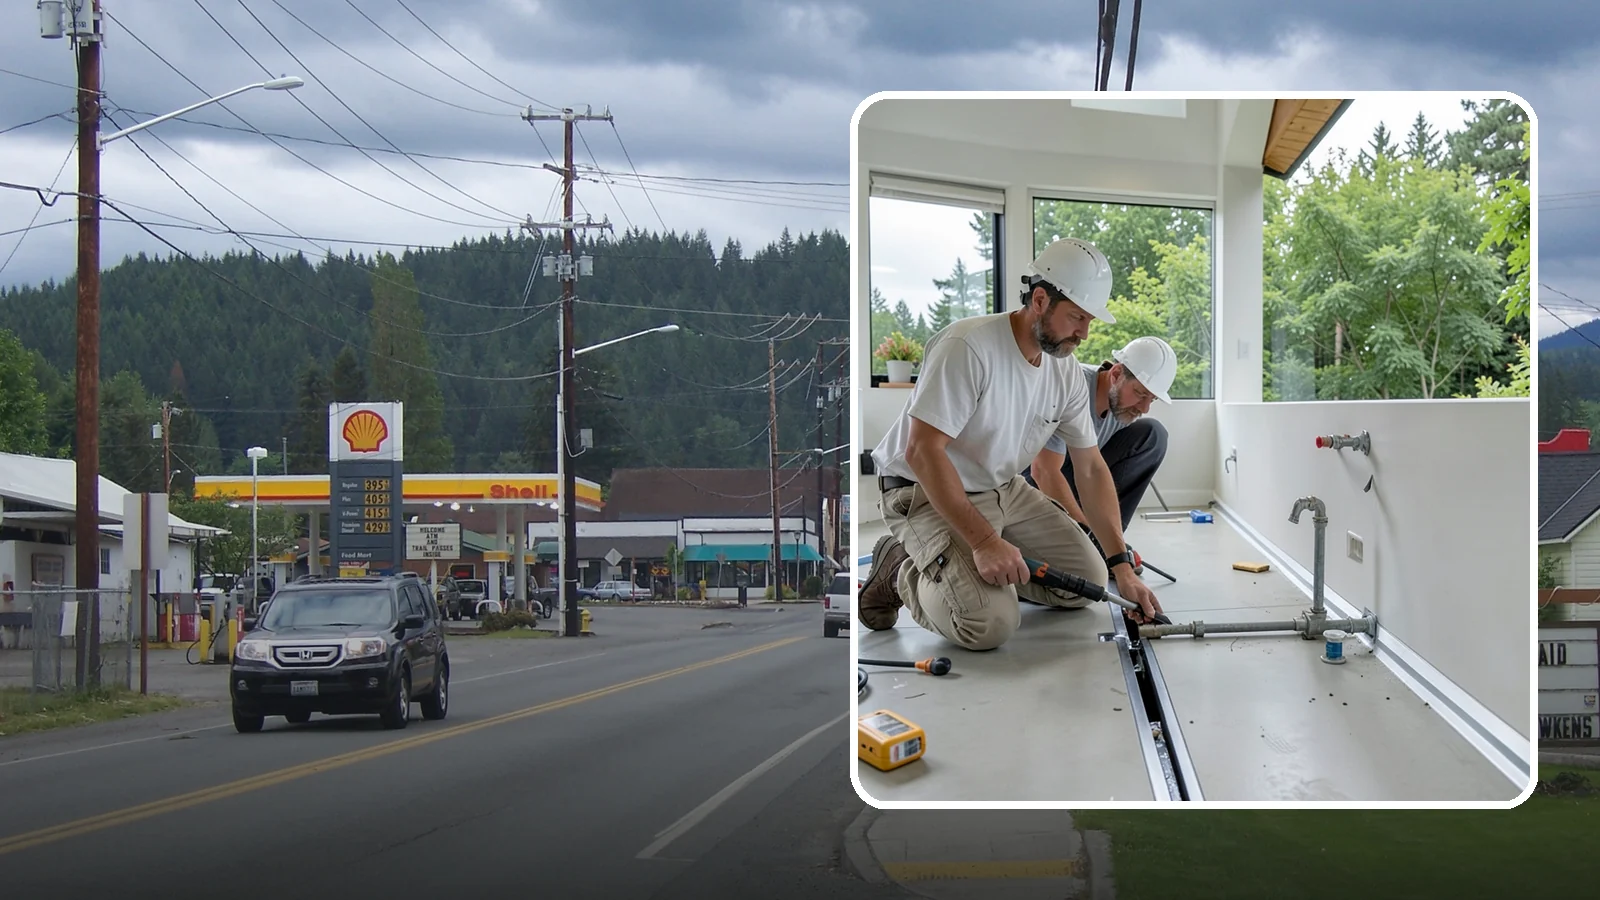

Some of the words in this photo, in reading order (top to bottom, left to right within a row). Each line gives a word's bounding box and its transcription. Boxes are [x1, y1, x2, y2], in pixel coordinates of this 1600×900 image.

[365, 480, 383, 490] 395
[490, 484, 547, 499] Shell
[365, 494, 383, 504] 405
[365, 508, 383, 518] 415
[365, 522, 383, 532] 429
